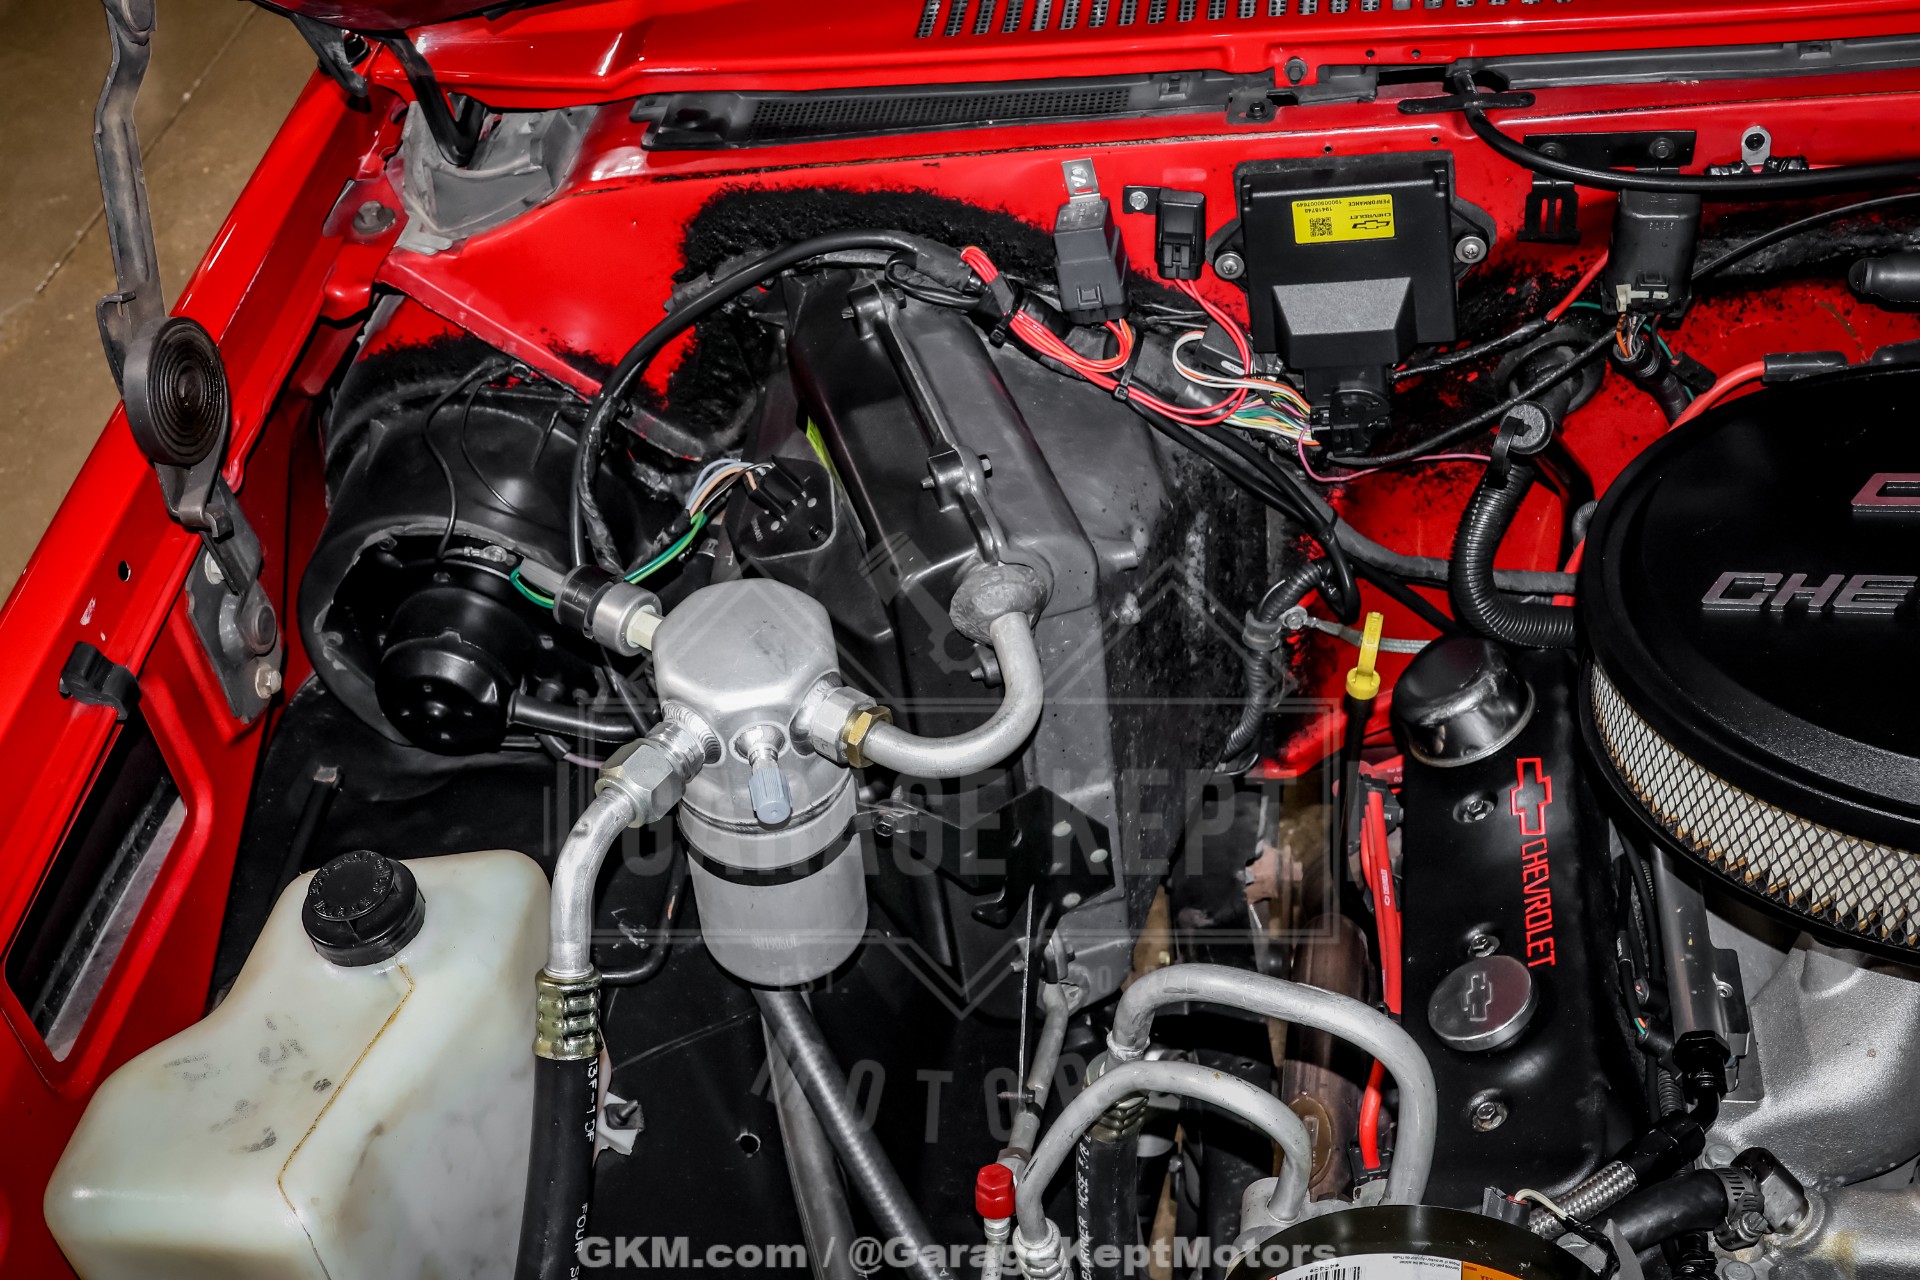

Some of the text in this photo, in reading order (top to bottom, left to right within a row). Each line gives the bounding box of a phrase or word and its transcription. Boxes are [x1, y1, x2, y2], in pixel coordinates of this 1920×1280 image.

[1348, 198, 1391, 207] PERFORMANCE
[1349, 212, 1392, 220] CHEVROLET
[1521, 838, 1555, 967] CHEVROLET
[1077, 1171, 1089, 1210] HOSE
[574, 1202, 588, 1254] FOUR
[1079, 1216, 1093, 1280] BARRIER
